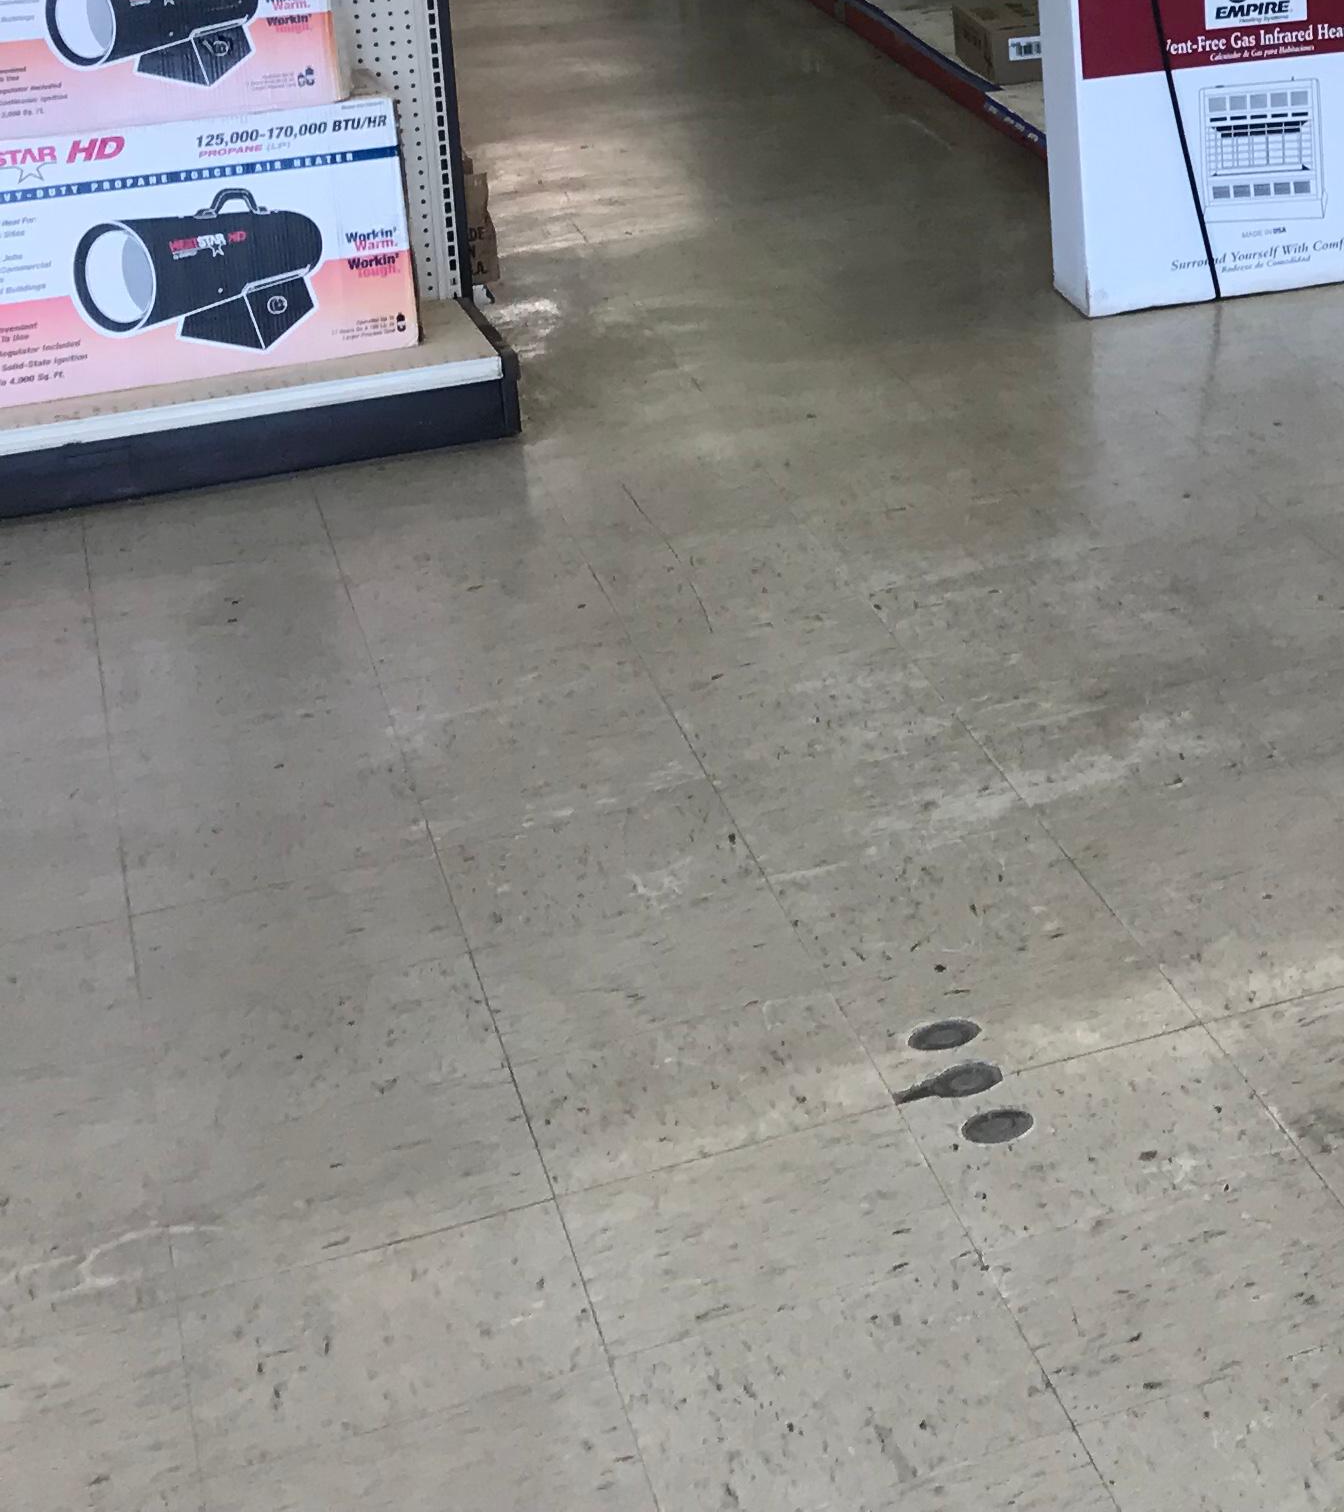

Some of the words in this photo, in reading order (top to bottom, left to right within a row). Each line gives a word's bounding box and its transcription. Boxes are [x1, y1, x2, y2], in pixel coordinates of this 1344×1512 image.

[1215, 0, 1290, 19] EMPIRE
[266, 14, 312, 27] Workin'
[1231, 32, 1255, 48] Gas
[1260, 24, 1314, 46] Infrared
[196, 121, 328, 148] 125,000-170,000
[332, 114, 387, 133] BTU/HR
[67, 136, 125, 164] HD
[198, 144, 263, 159] PROPANE
[90, 173, 168, 192] PROPANE
[180, 164, 244, 181] FORCED
[255, 160, 282, 172] AIR
[293, 152, 354, 169] HEATER
[345, 226, 397, 245] Workin'
[356, 238, 398, 252] Warm.
[347, 254, 399, 270] Workin'
[1231, 245, 1277, 263] Yourself
[1282, 242, 1309, 255] With
